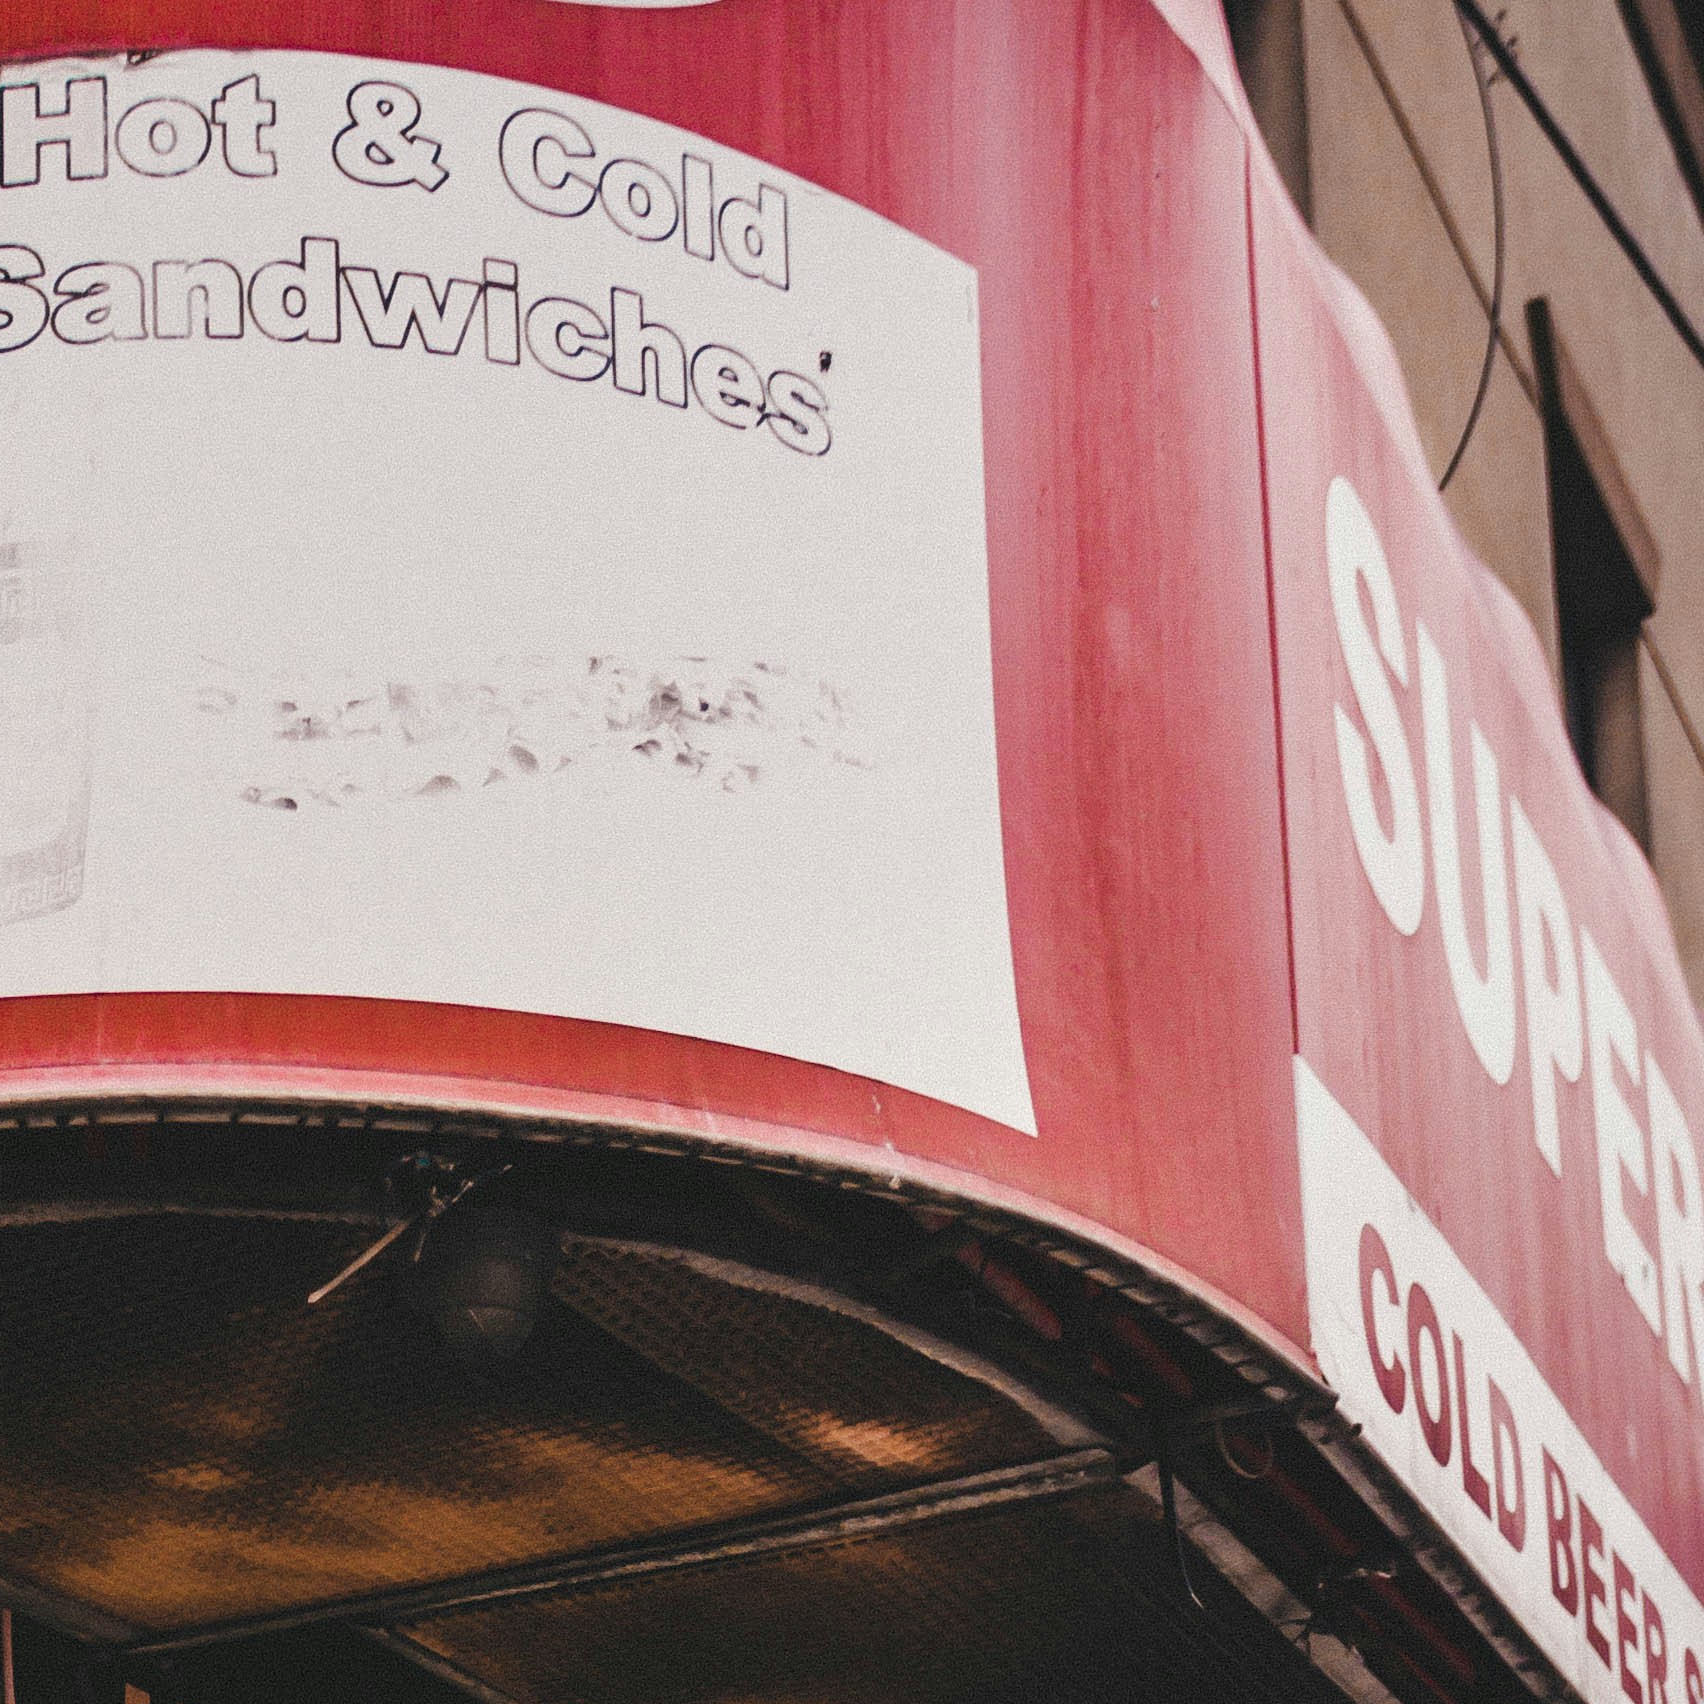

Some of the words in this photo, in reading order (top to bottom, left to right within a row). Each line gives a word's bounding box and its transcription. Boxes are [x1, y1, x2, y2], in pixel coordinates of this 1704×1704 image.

[332, 80, 450, 191] &
[500, 108, 789, 290] Cold
[1358, 1224, 1524, 1554] COLD
